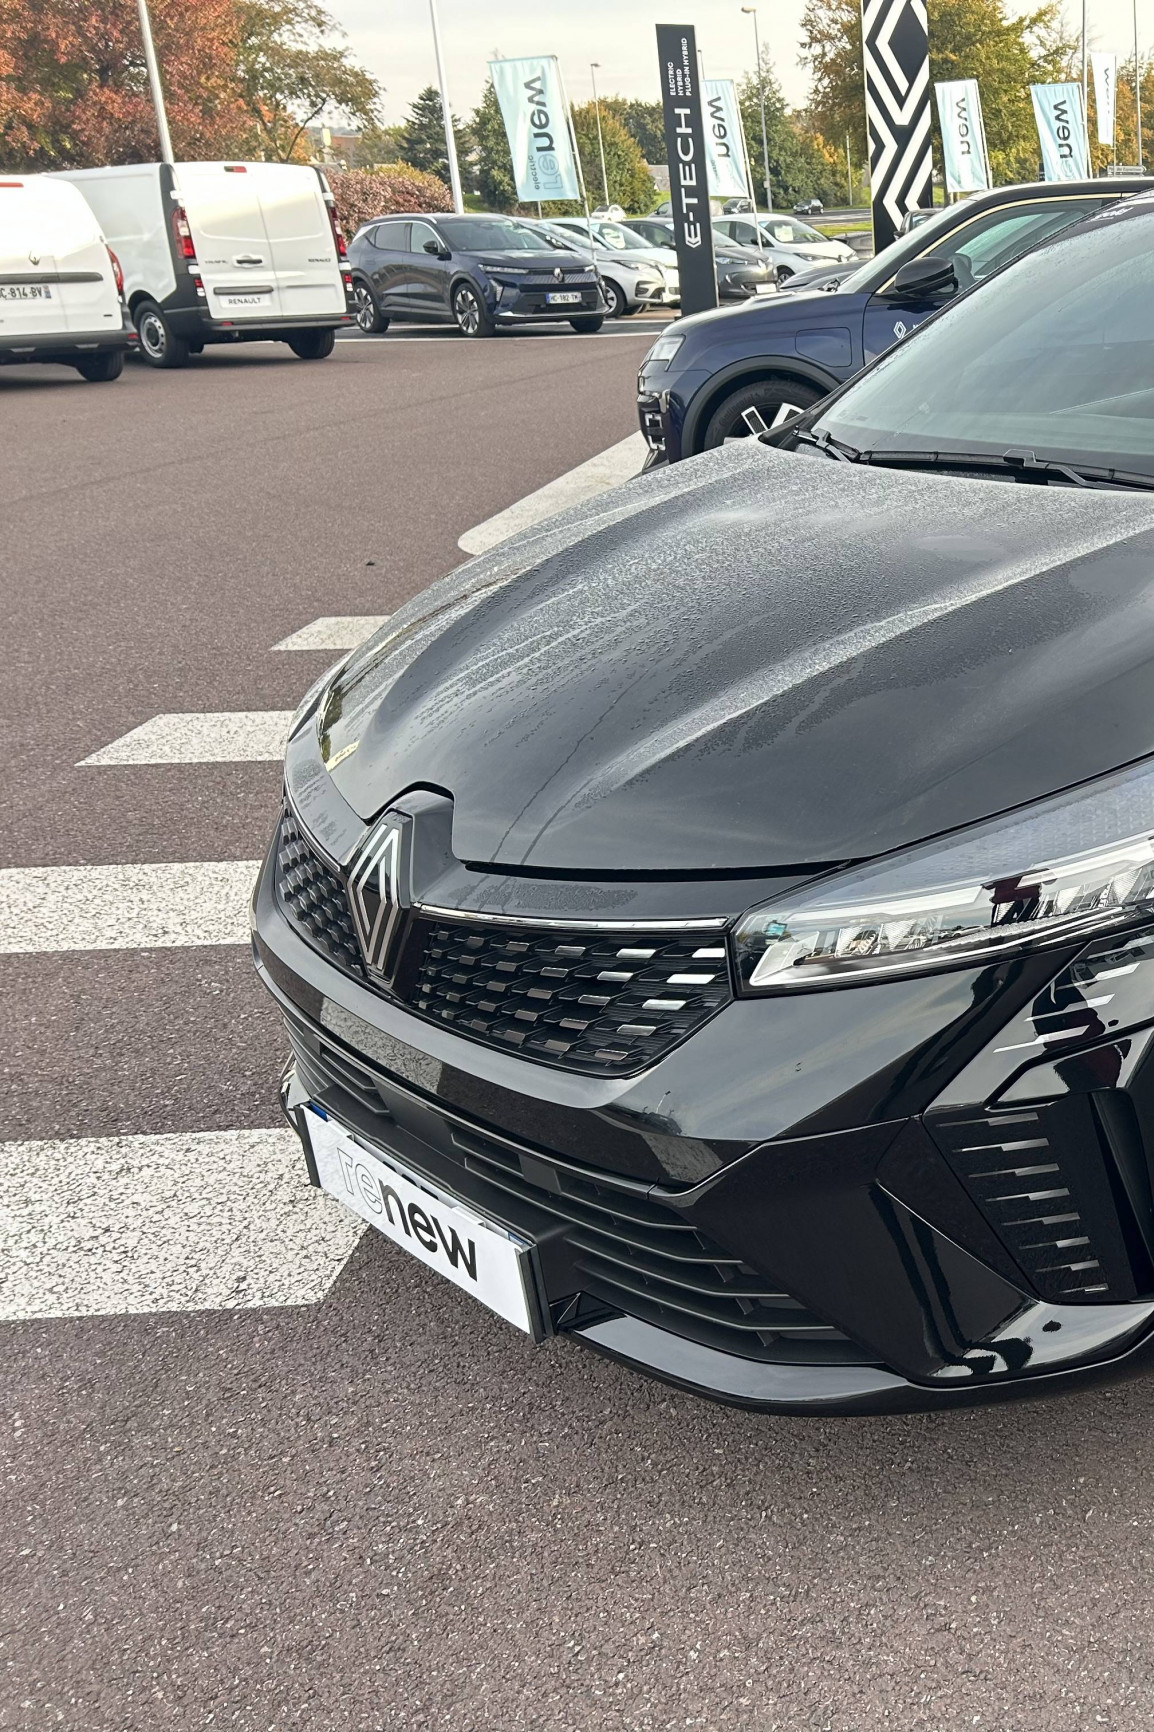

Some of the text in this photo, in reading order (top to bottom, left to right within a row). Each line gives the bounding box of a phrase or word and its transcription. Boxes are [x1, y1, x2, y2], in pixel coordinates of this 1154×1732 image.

[667, 61, 676, 96] ELECTRIC
[676, 68, 684, 96] HYBRID
[681, 37, 692, 96] PLUG-IN HYBRID
[528, 154, 541, 190] electric
[674, 107, 702, 249] E-TECH
[0, 286, 42, 299] C-814-BV
[228, 297, 262, 305] RENAULT
[336, 1146, 479, 1283] renew
